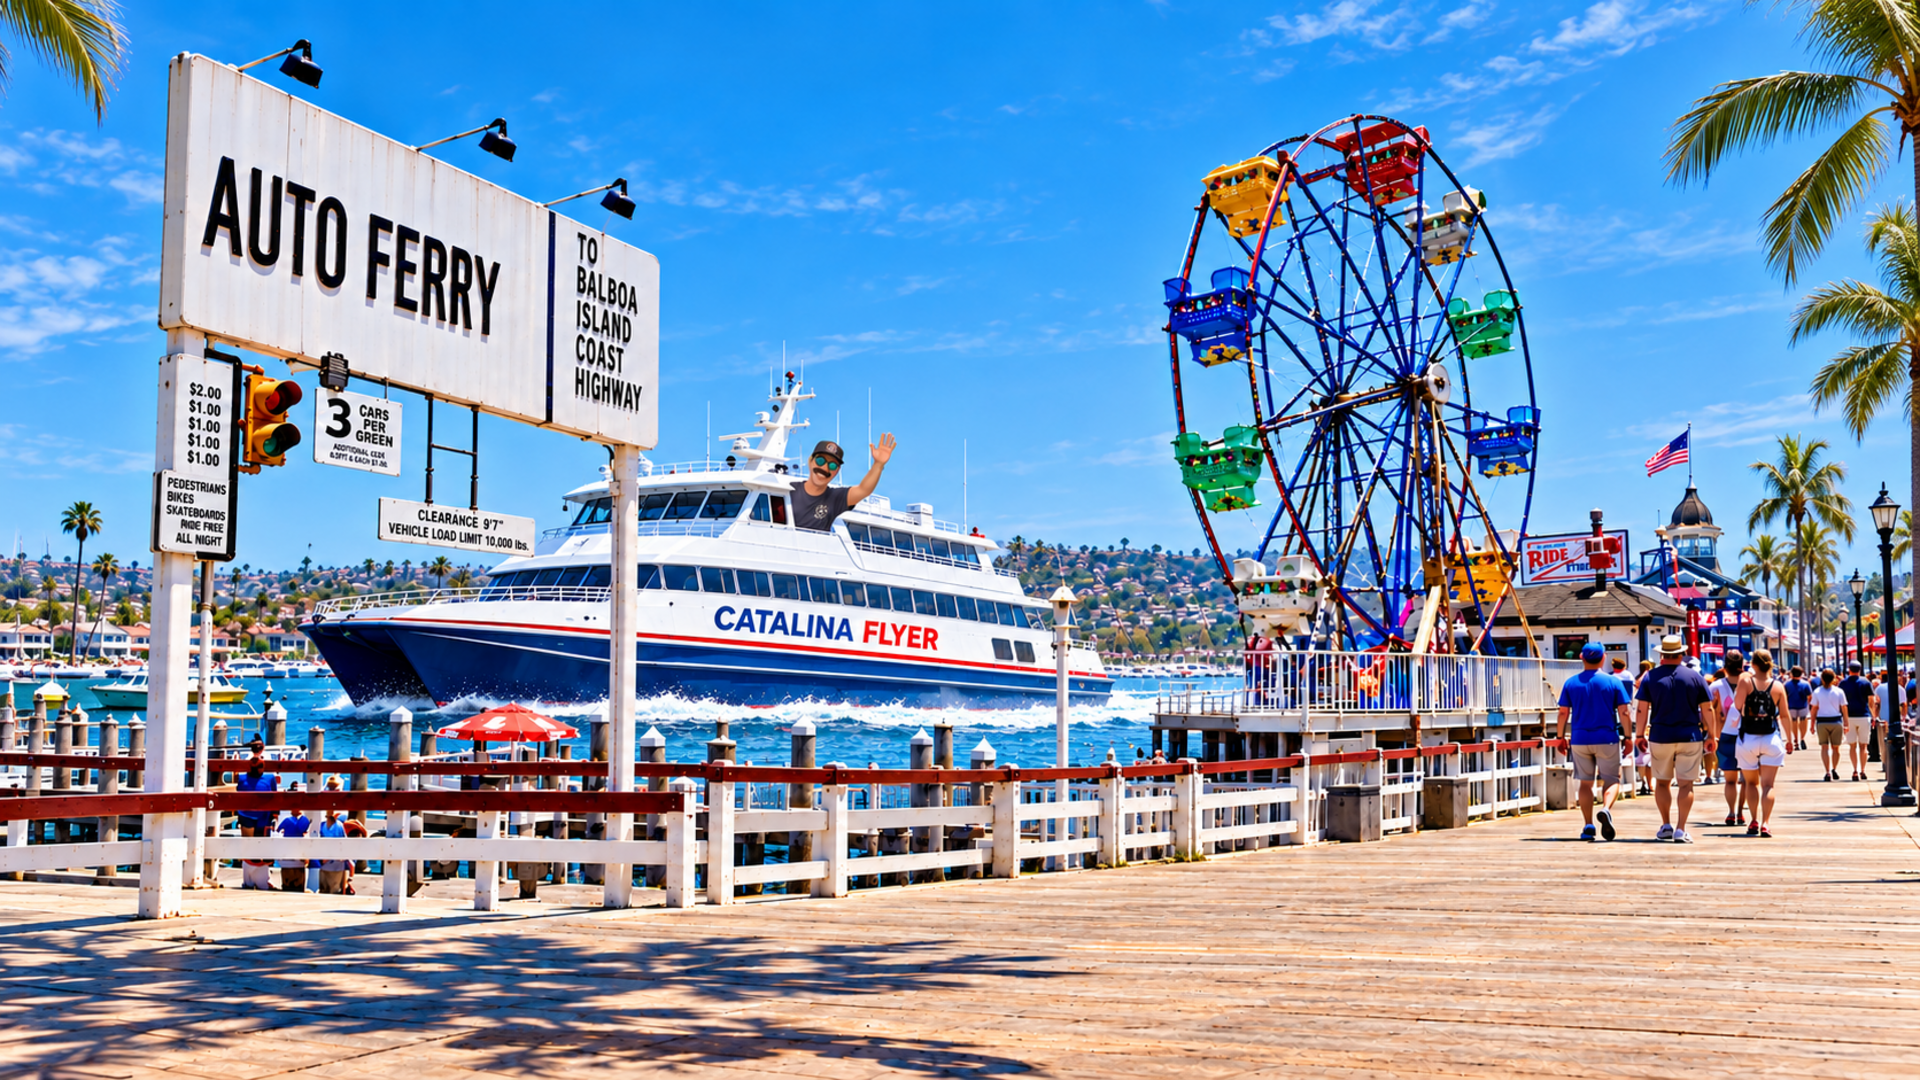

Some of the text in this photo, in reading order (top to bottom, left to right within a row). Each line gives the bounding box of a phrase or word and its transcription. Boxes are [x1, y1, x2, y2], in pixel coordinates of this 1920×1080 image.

[202, 155, 501, 336] AUTO FERRY
[577, 232, 598, 264] TO
[577, 265, 638, 315] BALBOA
[576, 300, 631, 343] ISLAND
[576, 334, 624, 374] COAST
[189, 382, 222, 400] $2.00
[575, 367, 642, 412] HIGHWAY
[189, 399, 221, 417] $1.00
[359, 404, 389, 421] CARS
[188, 416, 221, 434] $1.00
[325, 398, 351, 438] 3
[363, 418, 386, 433] PER
[187, 433, 220, 450] $1.00
[356, 430, 393, 447] GREEN
[187, 450, 220, 467] $1.00
[167, 477, 227, 495] PEDESTRIANS
[167, 491, 195, 504] BIKES
[166, 504, 226, 521] SKATEBOARDS
[418, 509, 479, 529] CLEARANCE
[203, 522, 224, 533] FREE
[388, 522, 429, 538] VEHICLE
[431, 528, 457, 542] LOAD
[459, 532, 483, 545] LIMIT
[485, 535, 513, 549] 10,000
[175, 533, 223, 546] ALL NIGHT
[1527, 548, 1569, 570] RIDE
[714, 605, 939, 651] CATALINA FLYER
